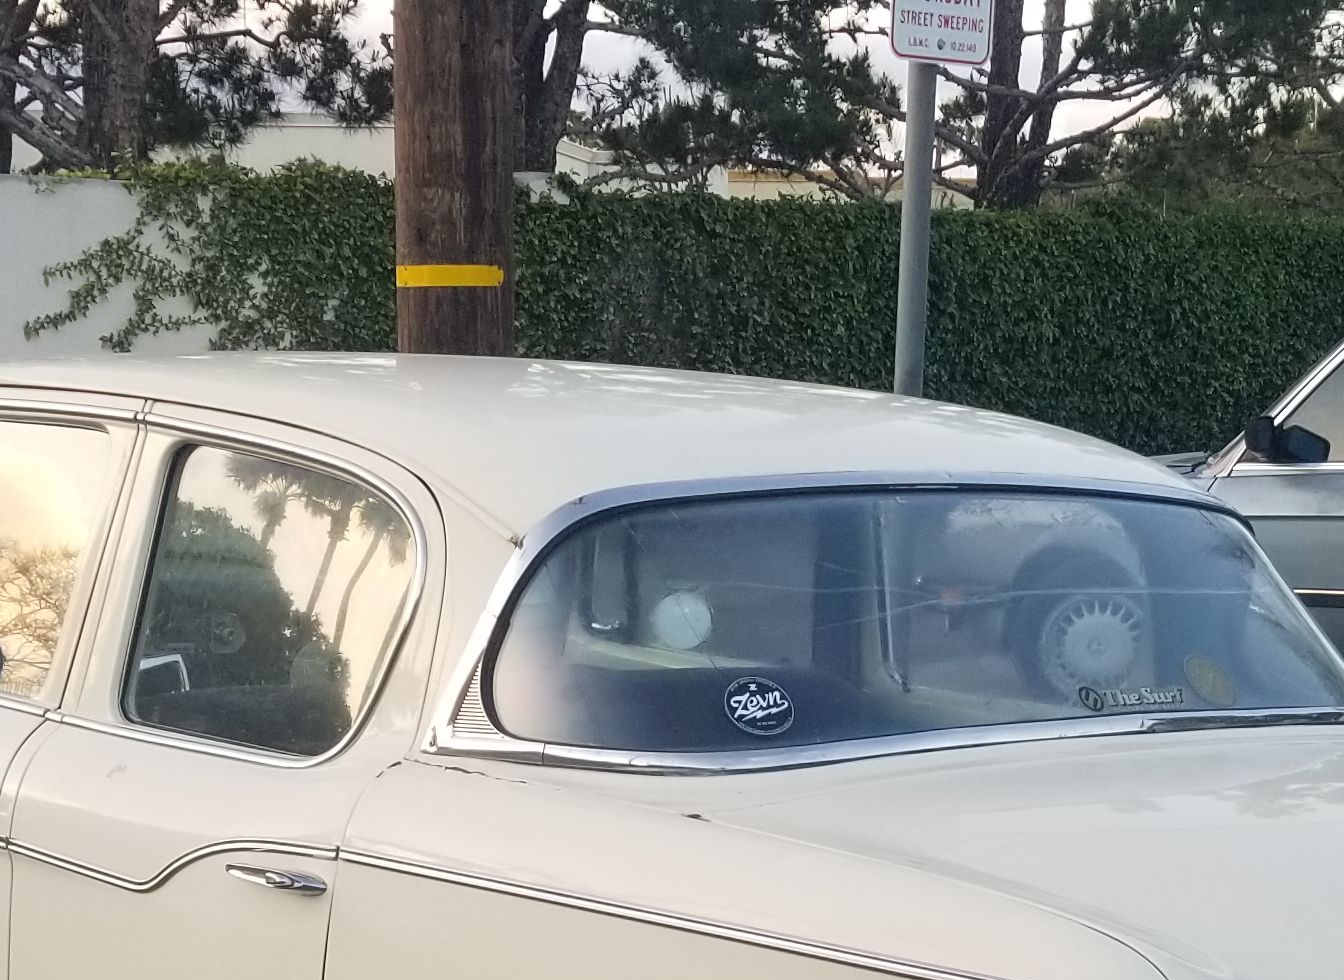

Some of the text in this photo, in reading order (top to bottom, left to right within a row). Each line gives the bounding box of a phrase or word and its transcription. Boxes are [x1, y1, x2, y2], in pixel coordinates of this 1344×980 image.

[899, 9, 984, 33] STREET SWEEPING
[1104, 688, 1141, 707] The
